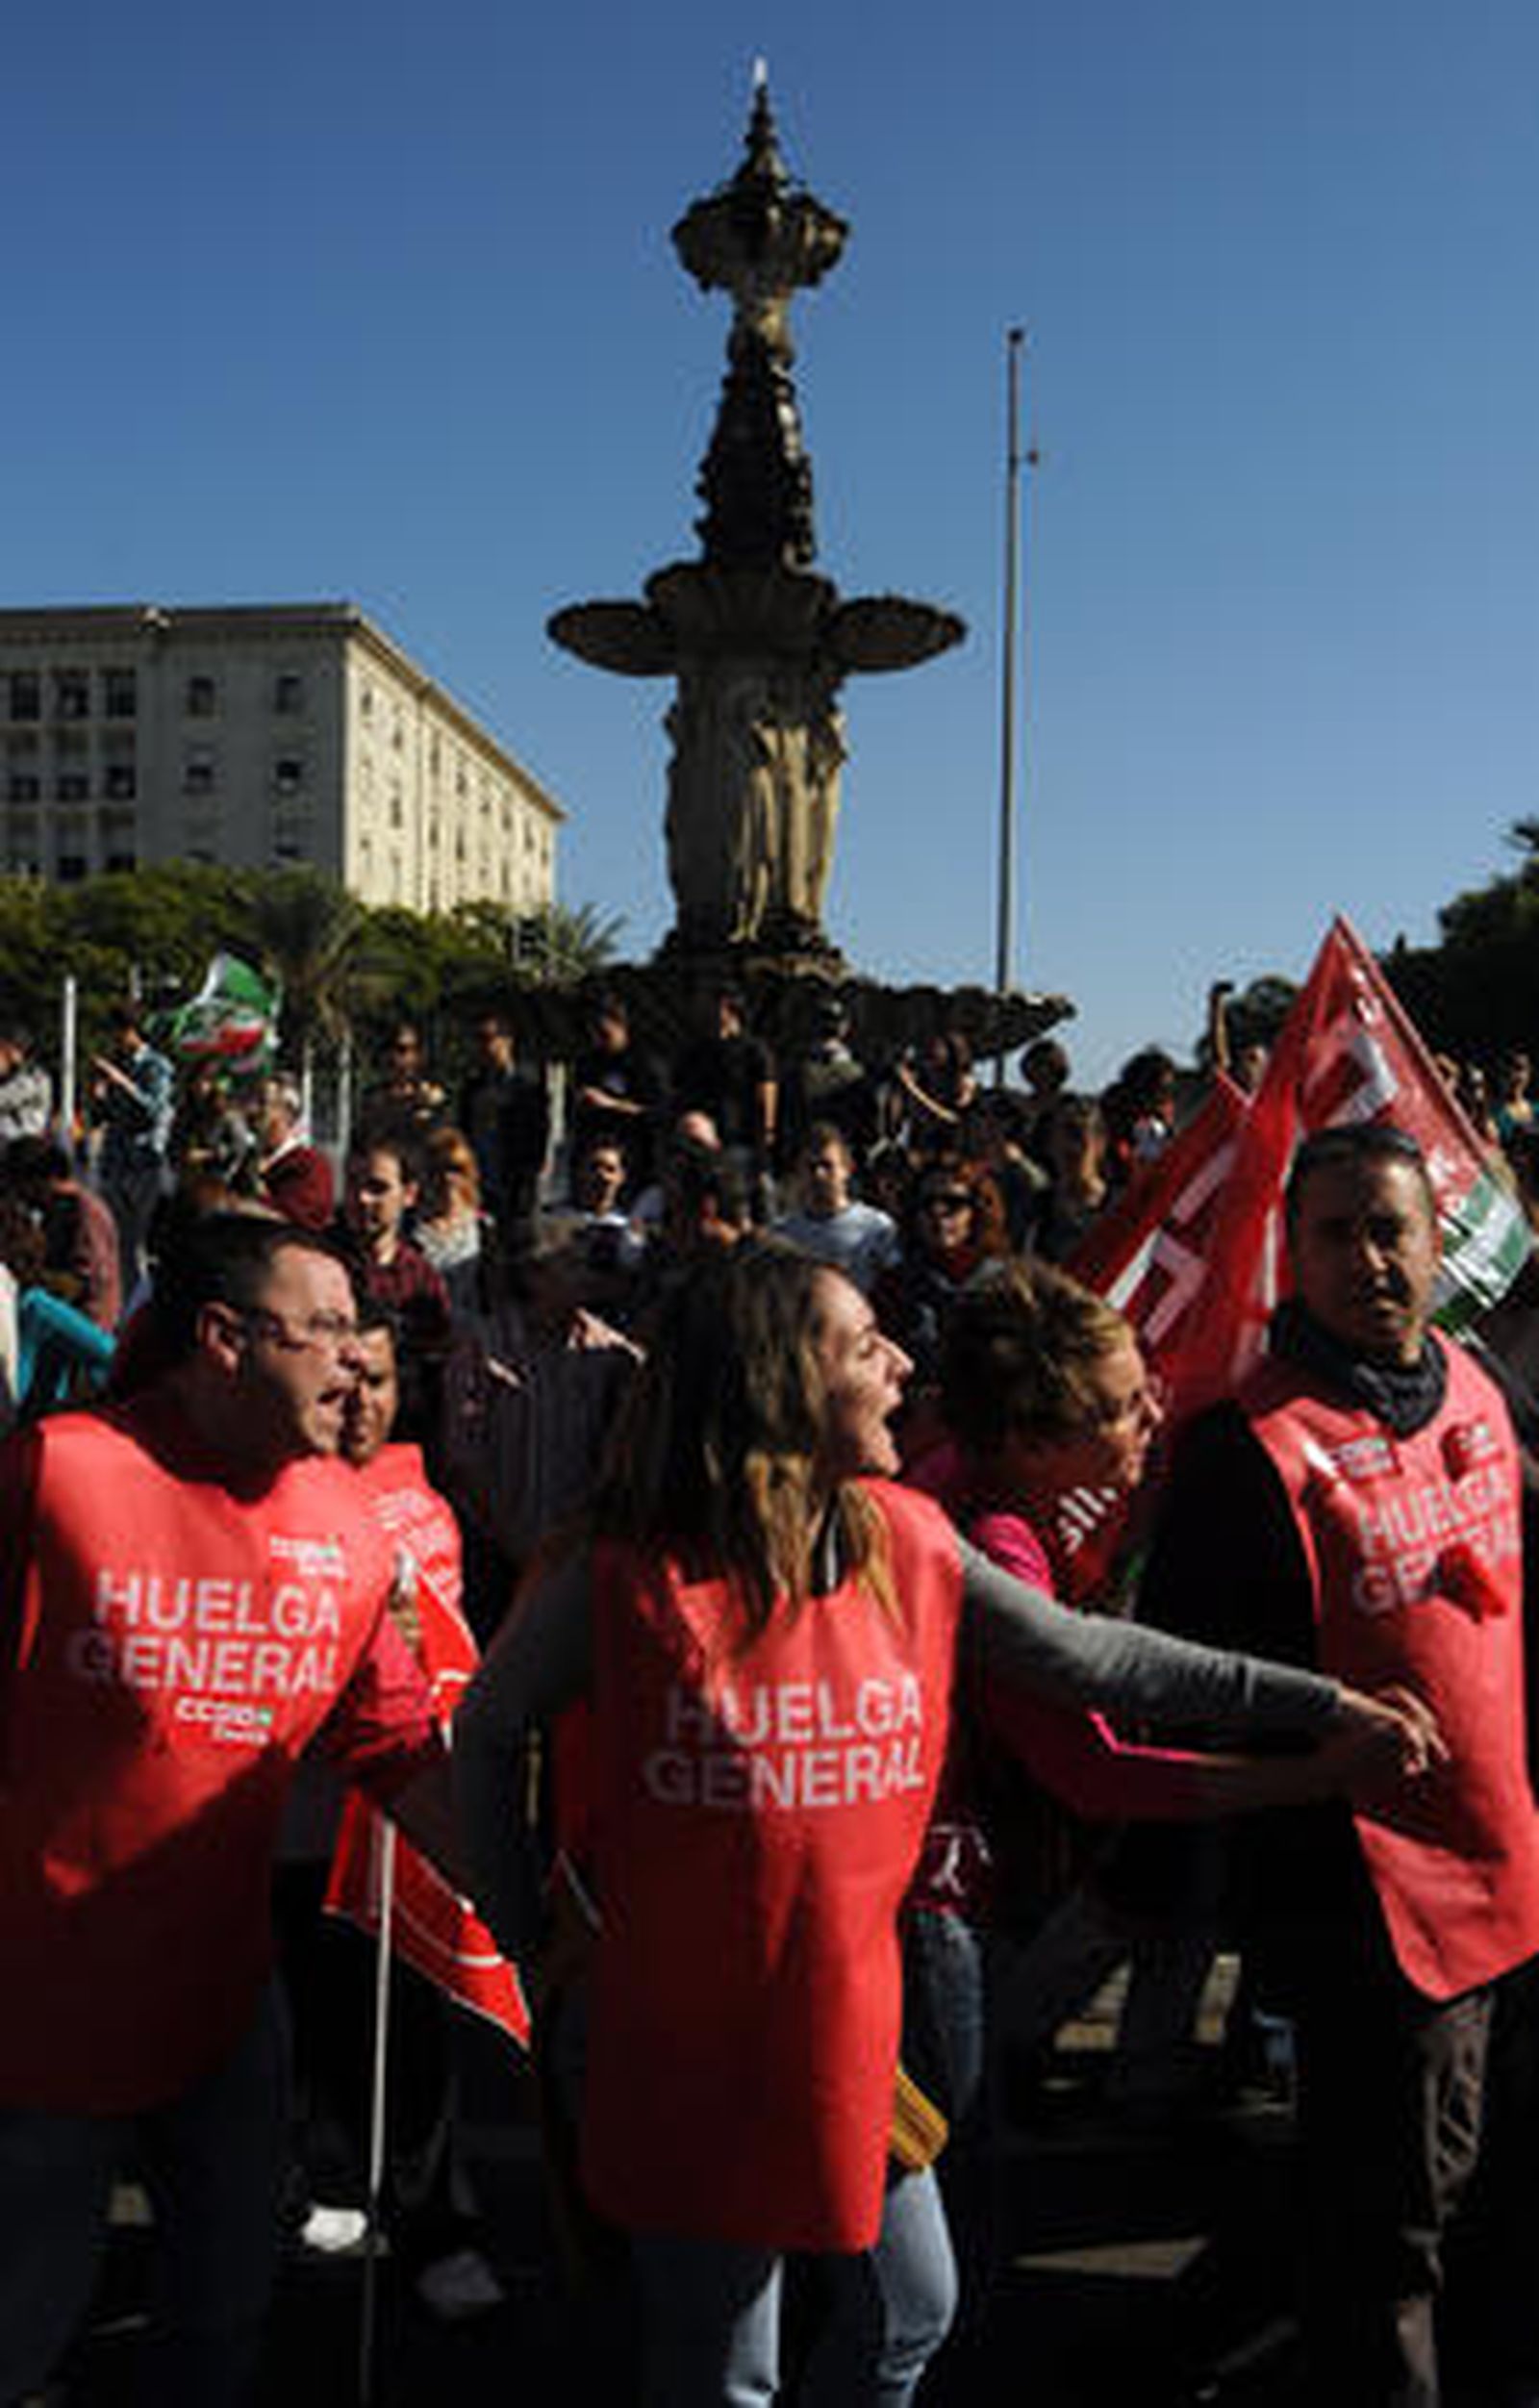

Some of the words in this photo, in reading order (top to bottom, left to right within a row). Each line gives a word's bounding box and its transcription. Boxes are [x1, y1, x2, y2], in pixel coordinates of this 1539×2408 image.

[96, 1568, 341, 1638] HUELGA
[66, 1631, 340, 1695] GENERAL
[667, 1672, 923, 1746] HUELGA
[643, 1735, 924, 1808] GENERAL
